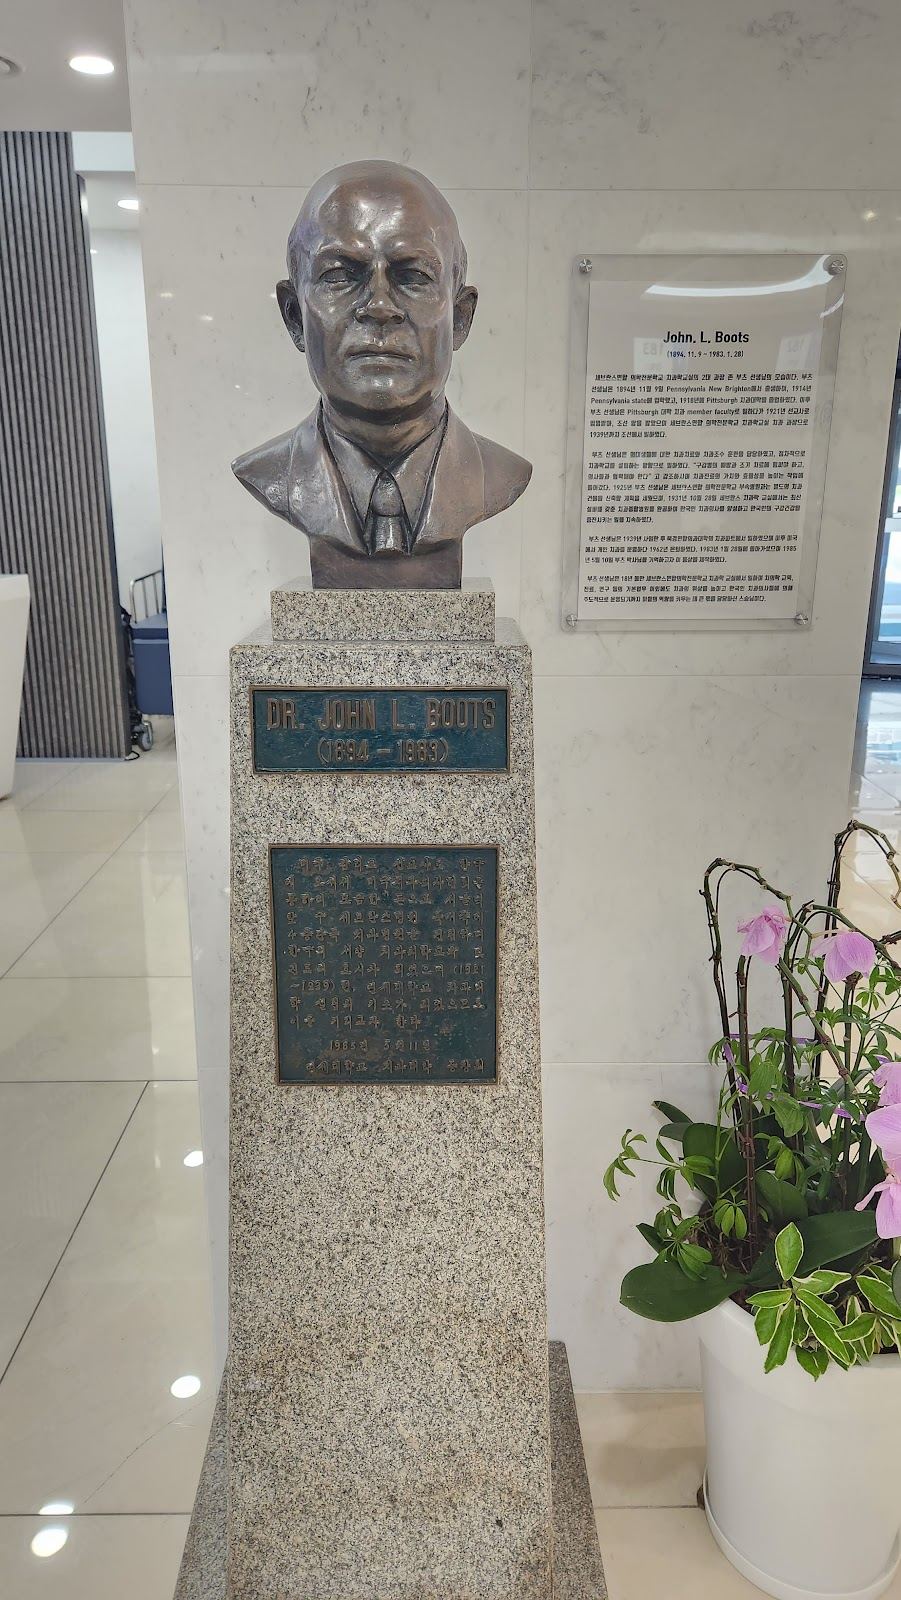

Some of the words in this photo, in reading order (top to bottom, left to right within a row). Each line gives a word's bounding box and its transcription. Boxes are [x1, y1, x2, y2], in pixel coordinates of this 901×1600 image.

[663, 331, 697, 344] John.
[700, 331, 711, 344] L.
[715, 331, 749, 344] Boots
[698, 350, 702, 358] 9
[616, 385, 636, 393] 1894년
[666, 385, 706, 394] Pennsylvania
[708, 385, 722, 393] New
[590, 397, 630, 406] Pennsylvania
[706, 396, 738, 405] Pittsburgh
[627, 408, 659, 417] Pittsburgh
[766, 407, 786, 415] 1921년
[267, 698, 305, 730] DR.
[318, 698, 376, 731] JOHN
[392, 698, 416, 730] L.
[426, 697, 496, 730] BOOTS
